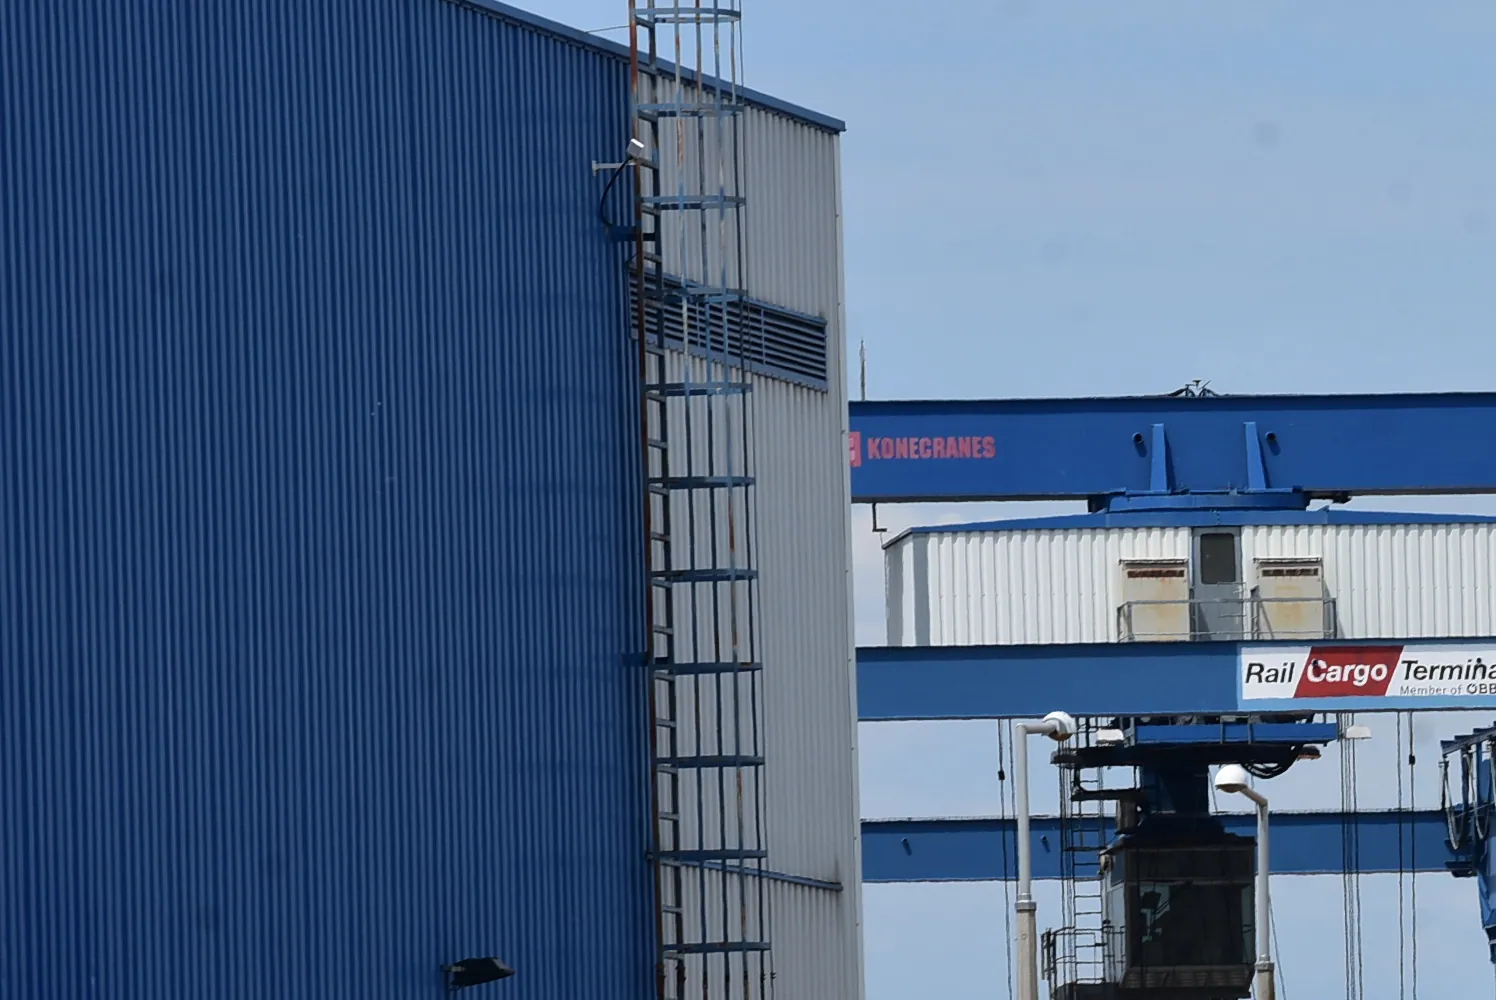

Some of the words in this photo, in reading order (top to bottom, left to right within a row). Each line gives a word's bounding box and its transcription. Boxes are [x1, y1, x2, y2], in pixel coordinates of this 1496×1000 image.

[868, 436, 995, 459] KONECRANES
[1245, 661, 1296, 684] Rail
[1306, 659, 1388, 686] Cargo
[1400, 685, 1447, 695] Member
[1450, 685, 1464, 695] of
